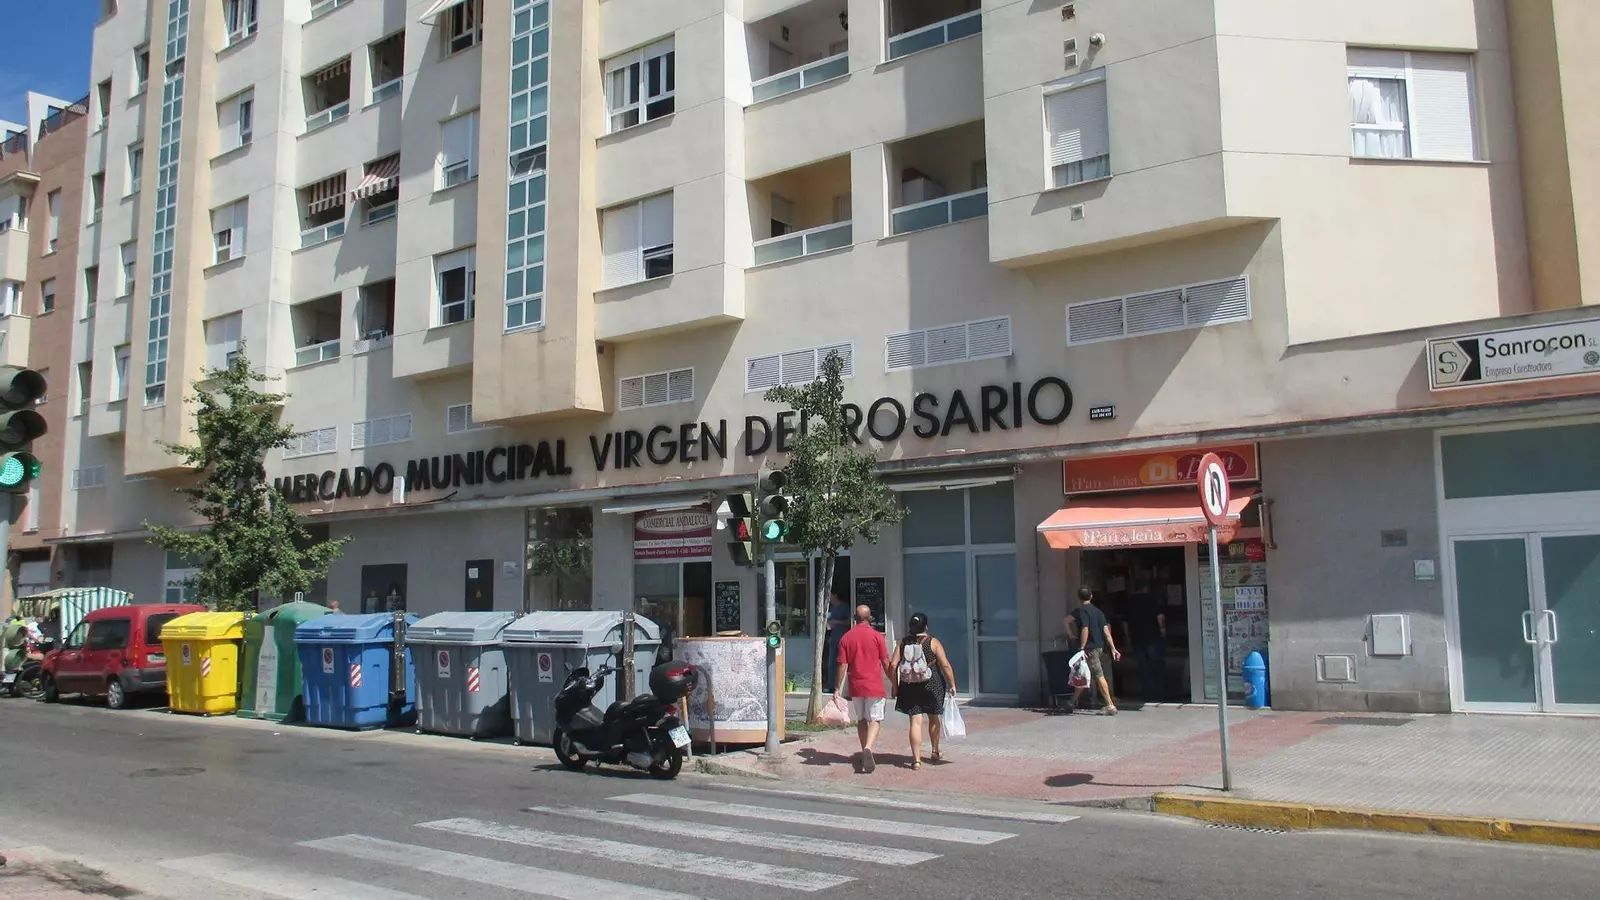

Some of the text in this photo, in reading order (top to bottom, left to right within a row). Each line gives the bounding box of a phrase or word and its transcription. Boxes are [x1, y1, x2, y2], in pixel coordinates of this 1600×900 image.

[1484, 333, 1586, 358] Sanrocon
[275, 462, 396, 504] MERCADO
[407, 440, 572, 493] MUNICIPAL
[590, 418, 727, 472] VIRGEN
[840, 376, 1074, 446] ROSARIO
[1131, 529, 1163, 541] leña
